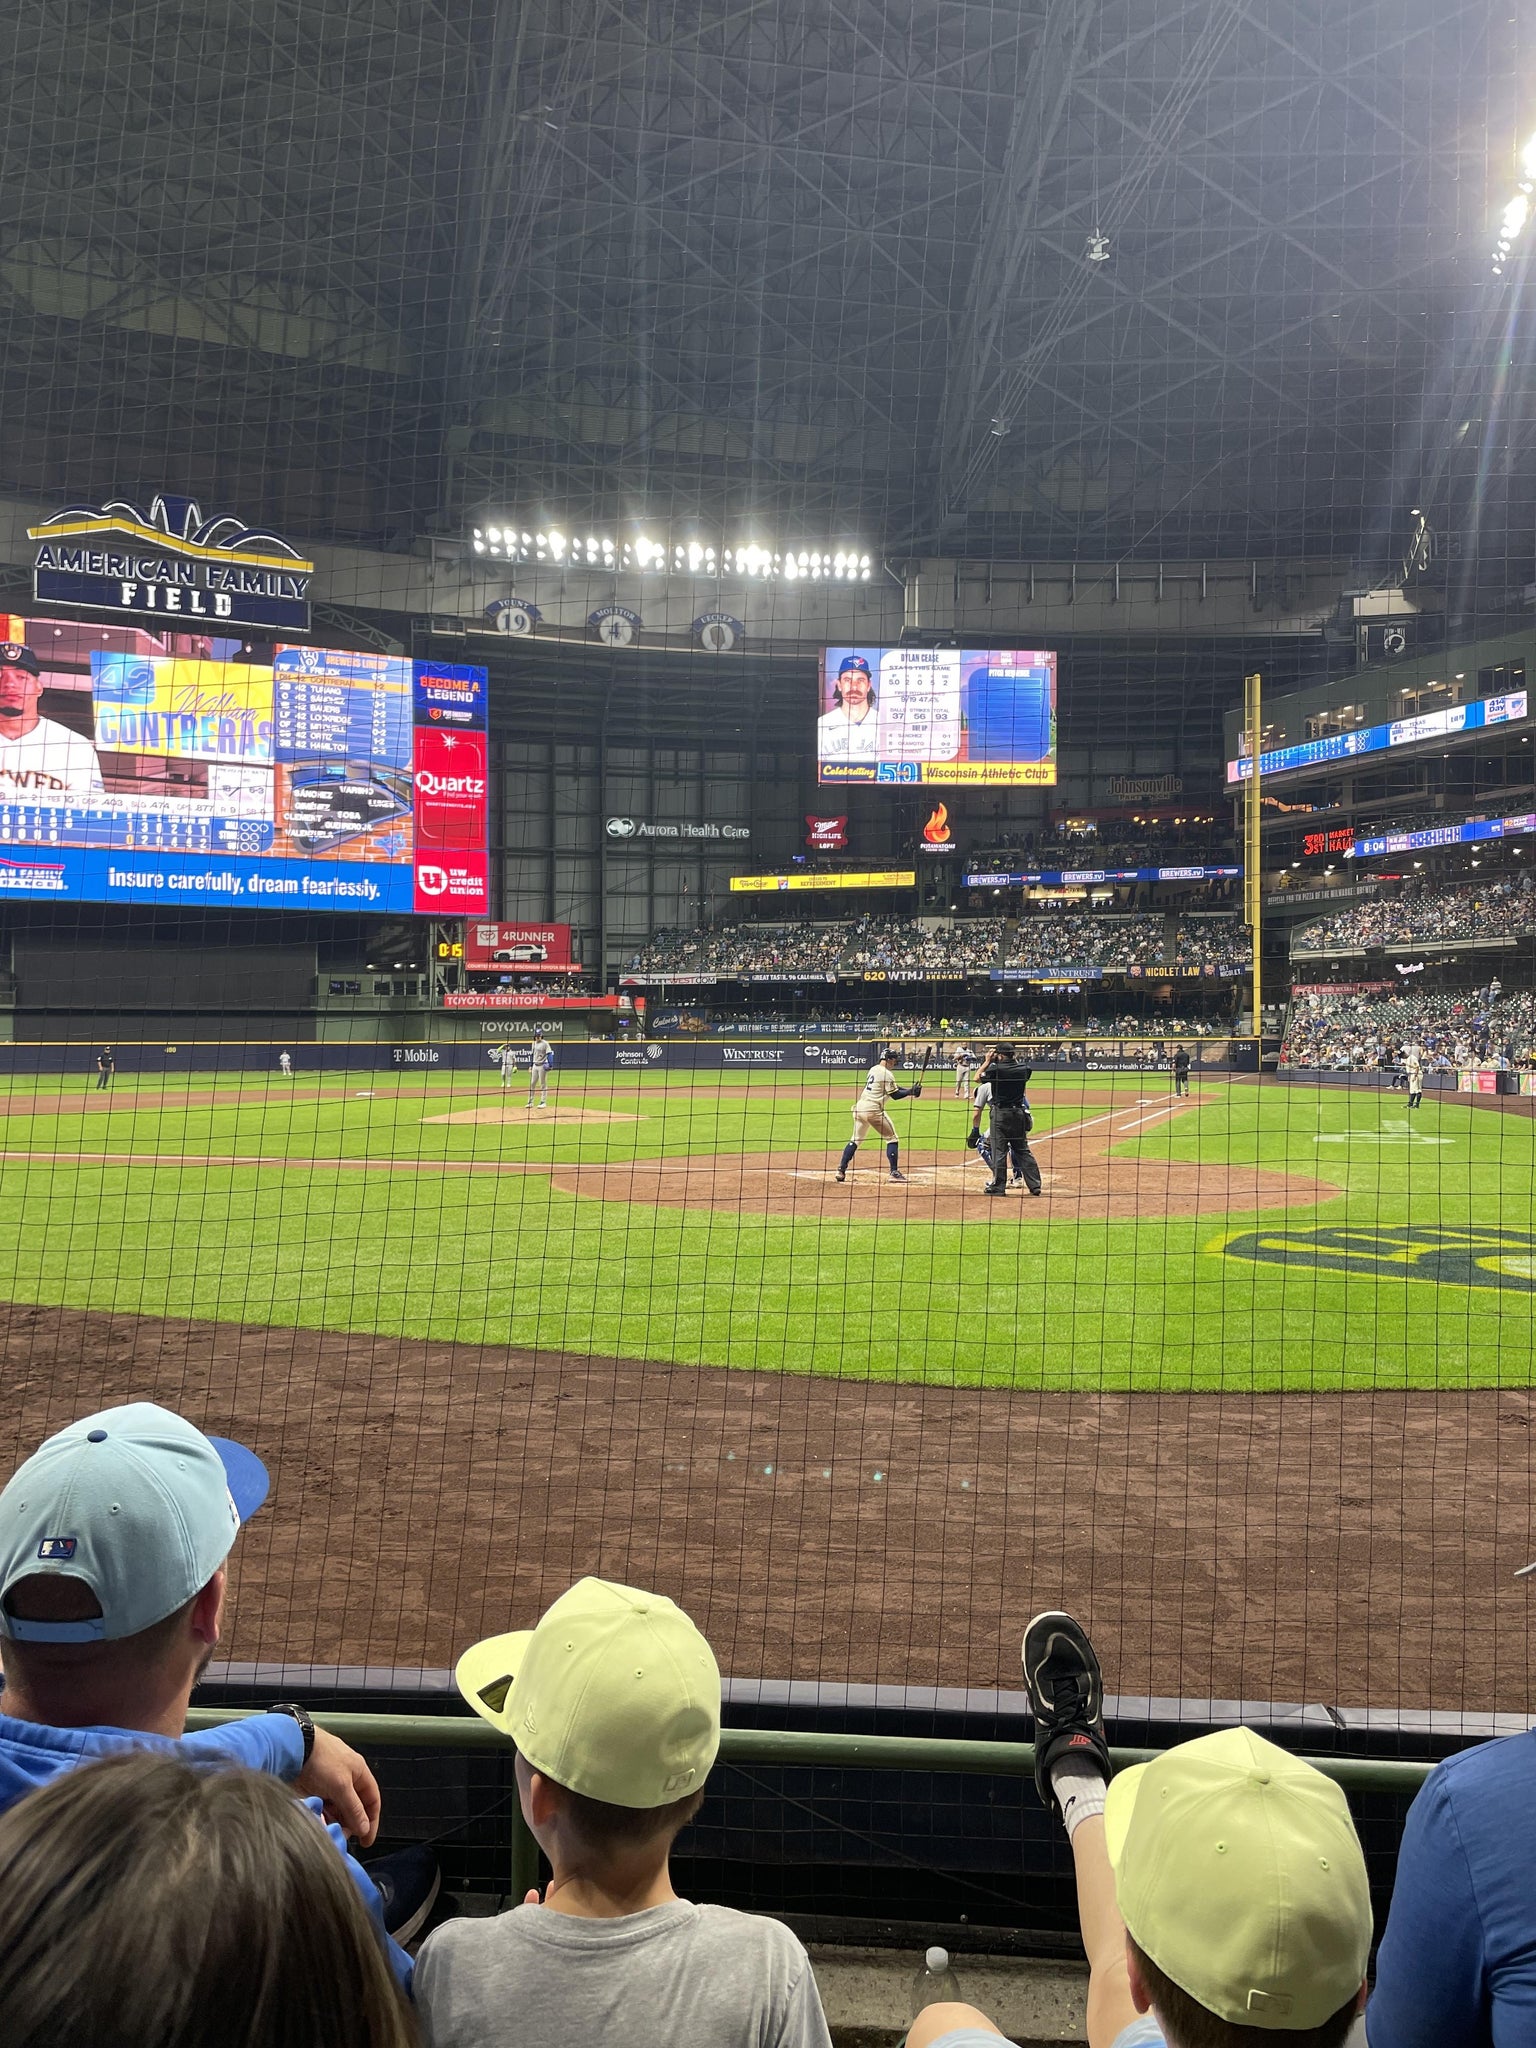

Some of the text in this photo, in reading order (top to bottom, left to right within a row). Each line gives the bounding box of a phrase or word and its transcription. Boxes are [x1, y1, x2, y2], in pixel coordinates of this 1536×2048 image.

[36, 544, 310, 600] AMERICAN FAMILY
[121, 581, 232, 617] FIELD
[596, 607, 636, 621] MOLITOR
[502, 614, 526, 631] 19
[609, 622, 621, 638] 4
[921, 654, 940, 662] CEASE
[94, 663, 154, 697] 42
[420, 676, 480, 692] BECOME A
[427, 688, 474, 702] LEGEND
[174, 685, 260, 722] William
[1489, 704, 1506, 713] Day
[100, 706, 273, 757] CONTRERAS
[823, 762, 1048, 782] Celebrating 50 Wisconsin Athletic Club
[416, 770, 484, 795] Quartz
[1106, 774, 1182, 796] Johnsonville
[82, 810, 88, 818] 7
[283, 810, 361, 822] CLEMENT SOSA
[638, 822, 750, 838] Aurora Health Care
[1329, 828, 1354, 838] MARKET
[1304, 833, 1324, 855] 3RD
[1313, 843, 1324, 854] ST
[1329, 837, 1354, 852] HALL
[1364, 840, 1384, 853] 8:04
[20, 868, 64, 880] FAMILY
[450, 868, 468, 876] uw
[168, 872, 244, 896] carefully,
[248, 874, 298, 894] dream
[302, 876, 380, 900] fearlessly.
[449, 877, 483, 886] credit
[450, 886, 484, 896] union
[502, 932, 554, 942] 4RUNNER
[438, 943, 463, 958] 0:15
[864, 971, 924, 980] 620 WTMJ
[1048, 968, 1098, 978] WINTRUST
[1145, 966, 1200, 976] NICOLET LAW
[447, 996, 545, 1006] TOYOTA TERRITORY
[480, 1021, 564, 1032] TOYOTA.COM
[820, 1024, 846, 1032] WELCOME
[404, 1048, 439, 1062] Mobile
[723, 1048, 784, 1060] WINTRUST
[820, 1056, 867, 1064] Health Care
